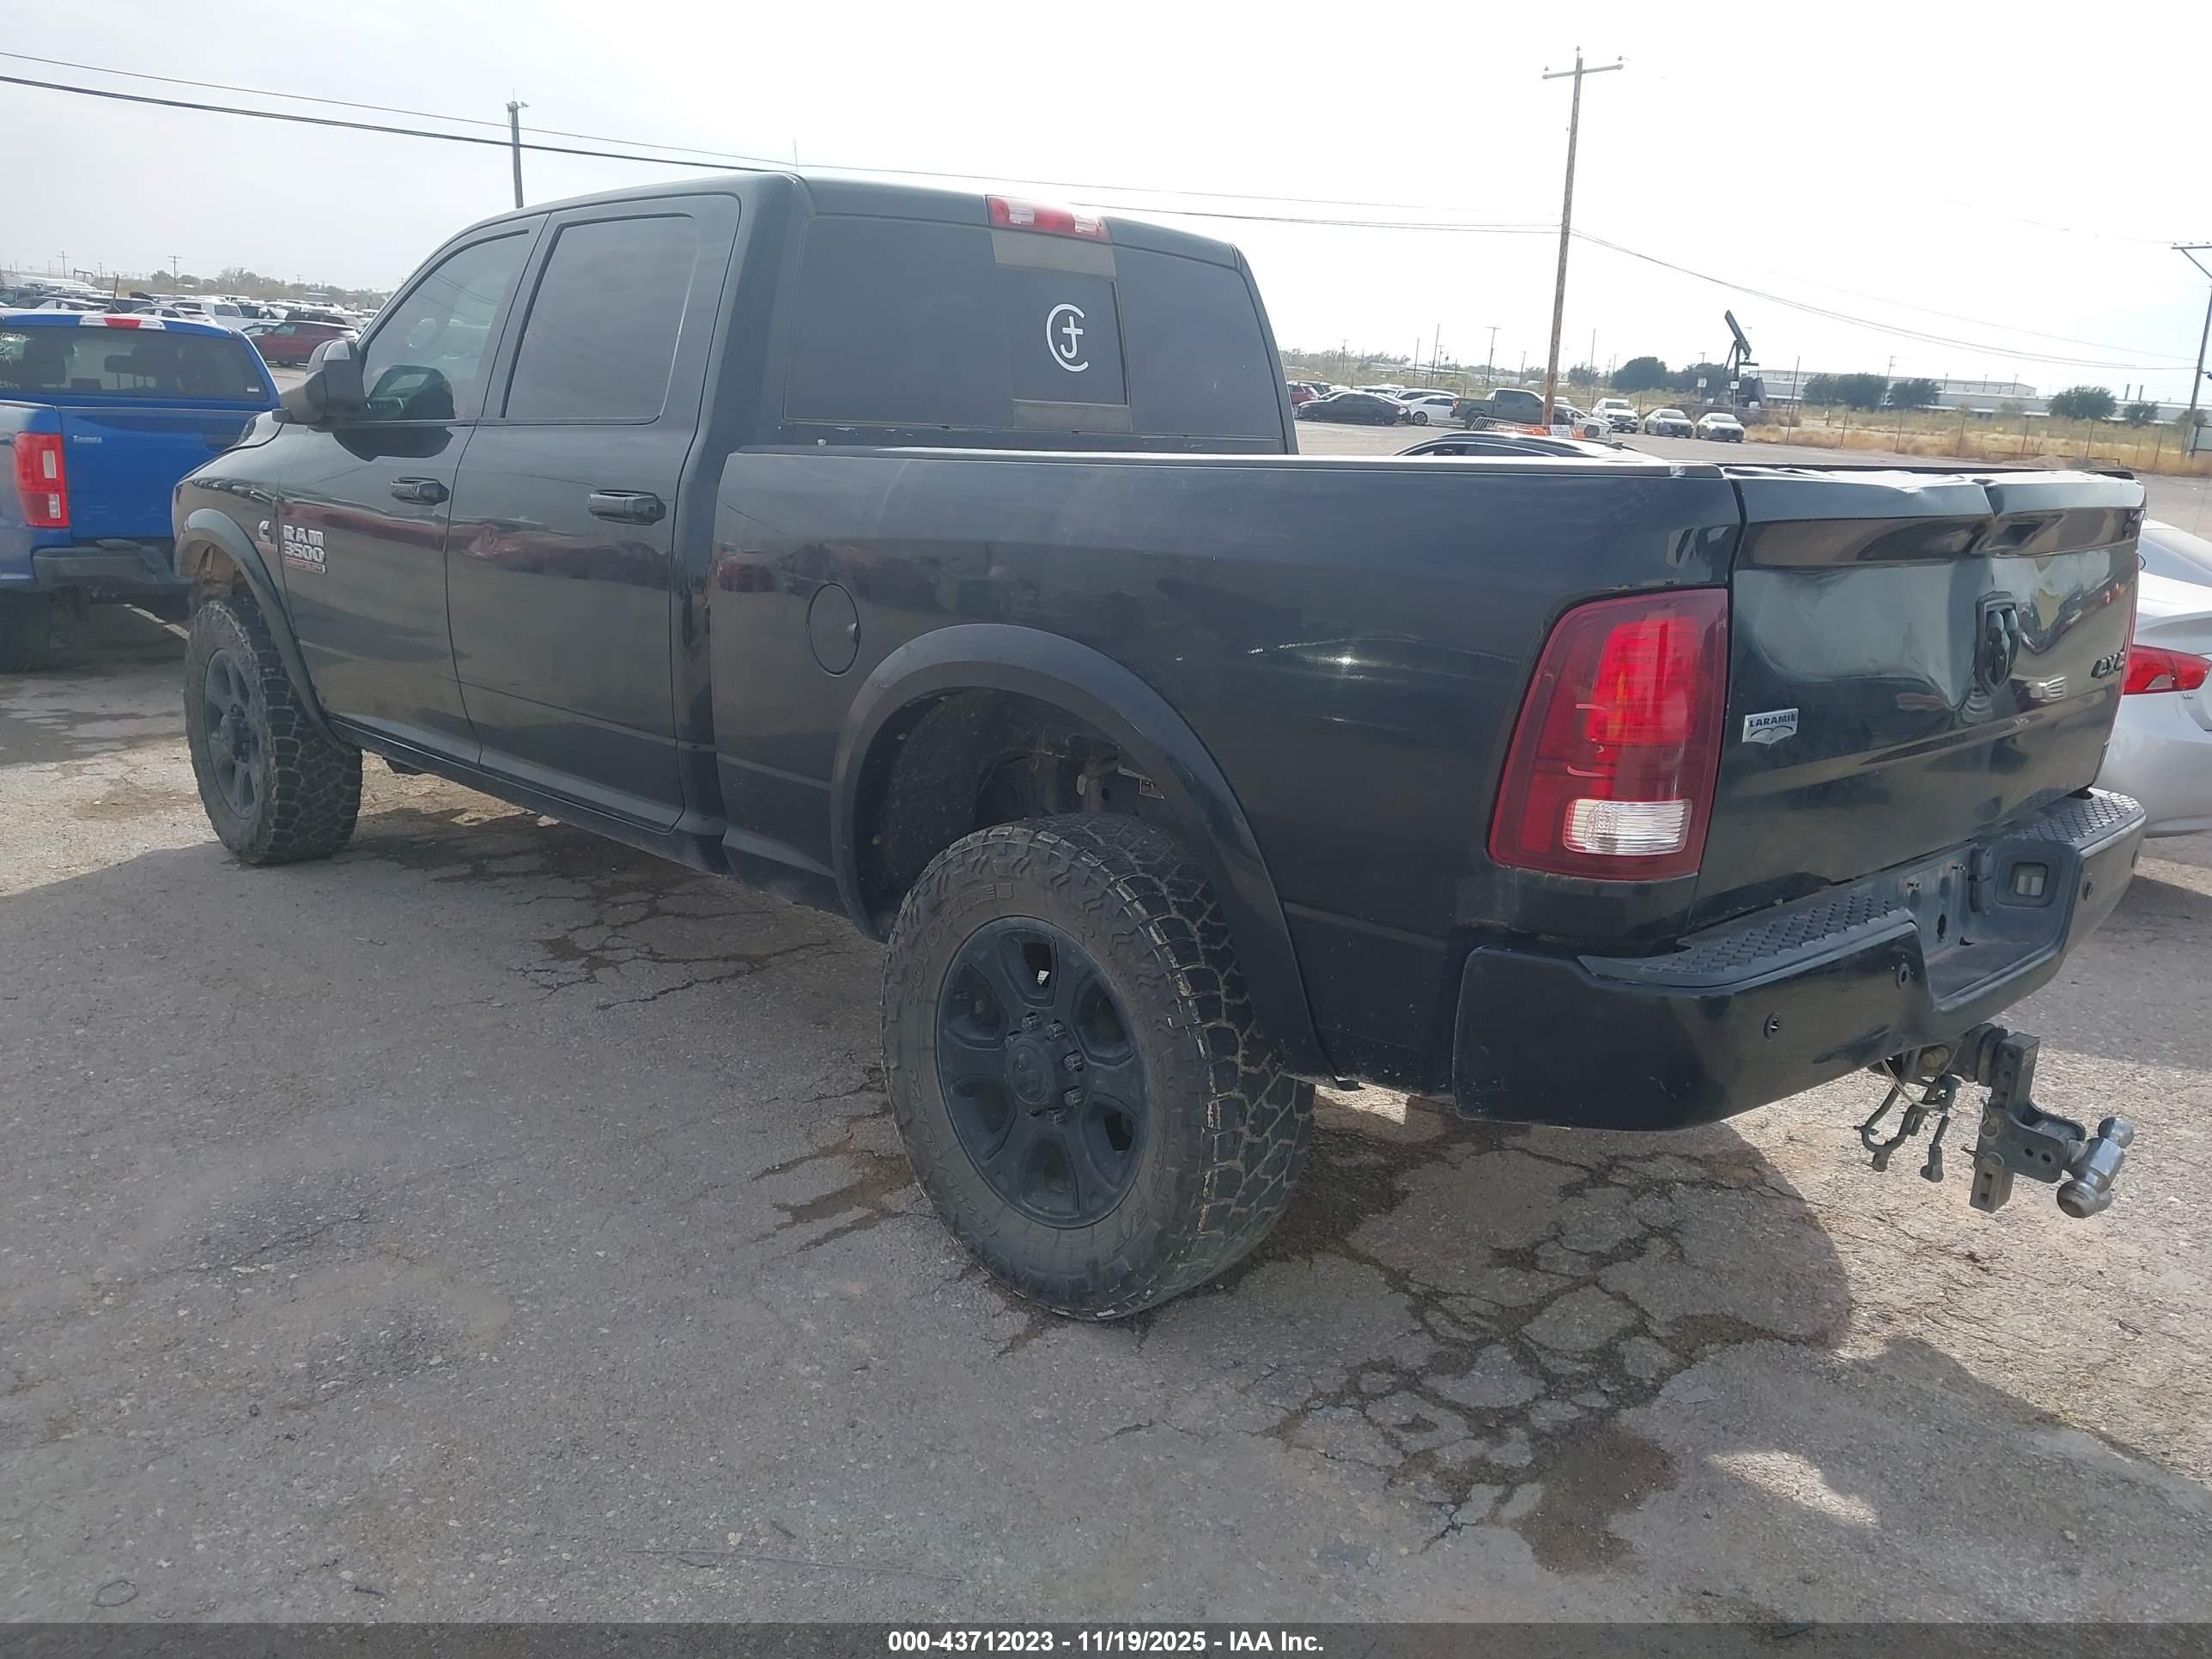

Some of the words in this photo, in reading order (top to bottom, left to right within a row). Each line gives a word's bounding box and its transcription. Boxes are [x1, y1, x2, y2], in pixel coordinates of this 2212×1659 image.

[283, 524, 325, 547] RAM
[284, 540, 325, 562] 3500
[1749, 714, 1797, 727] LARAMIE
